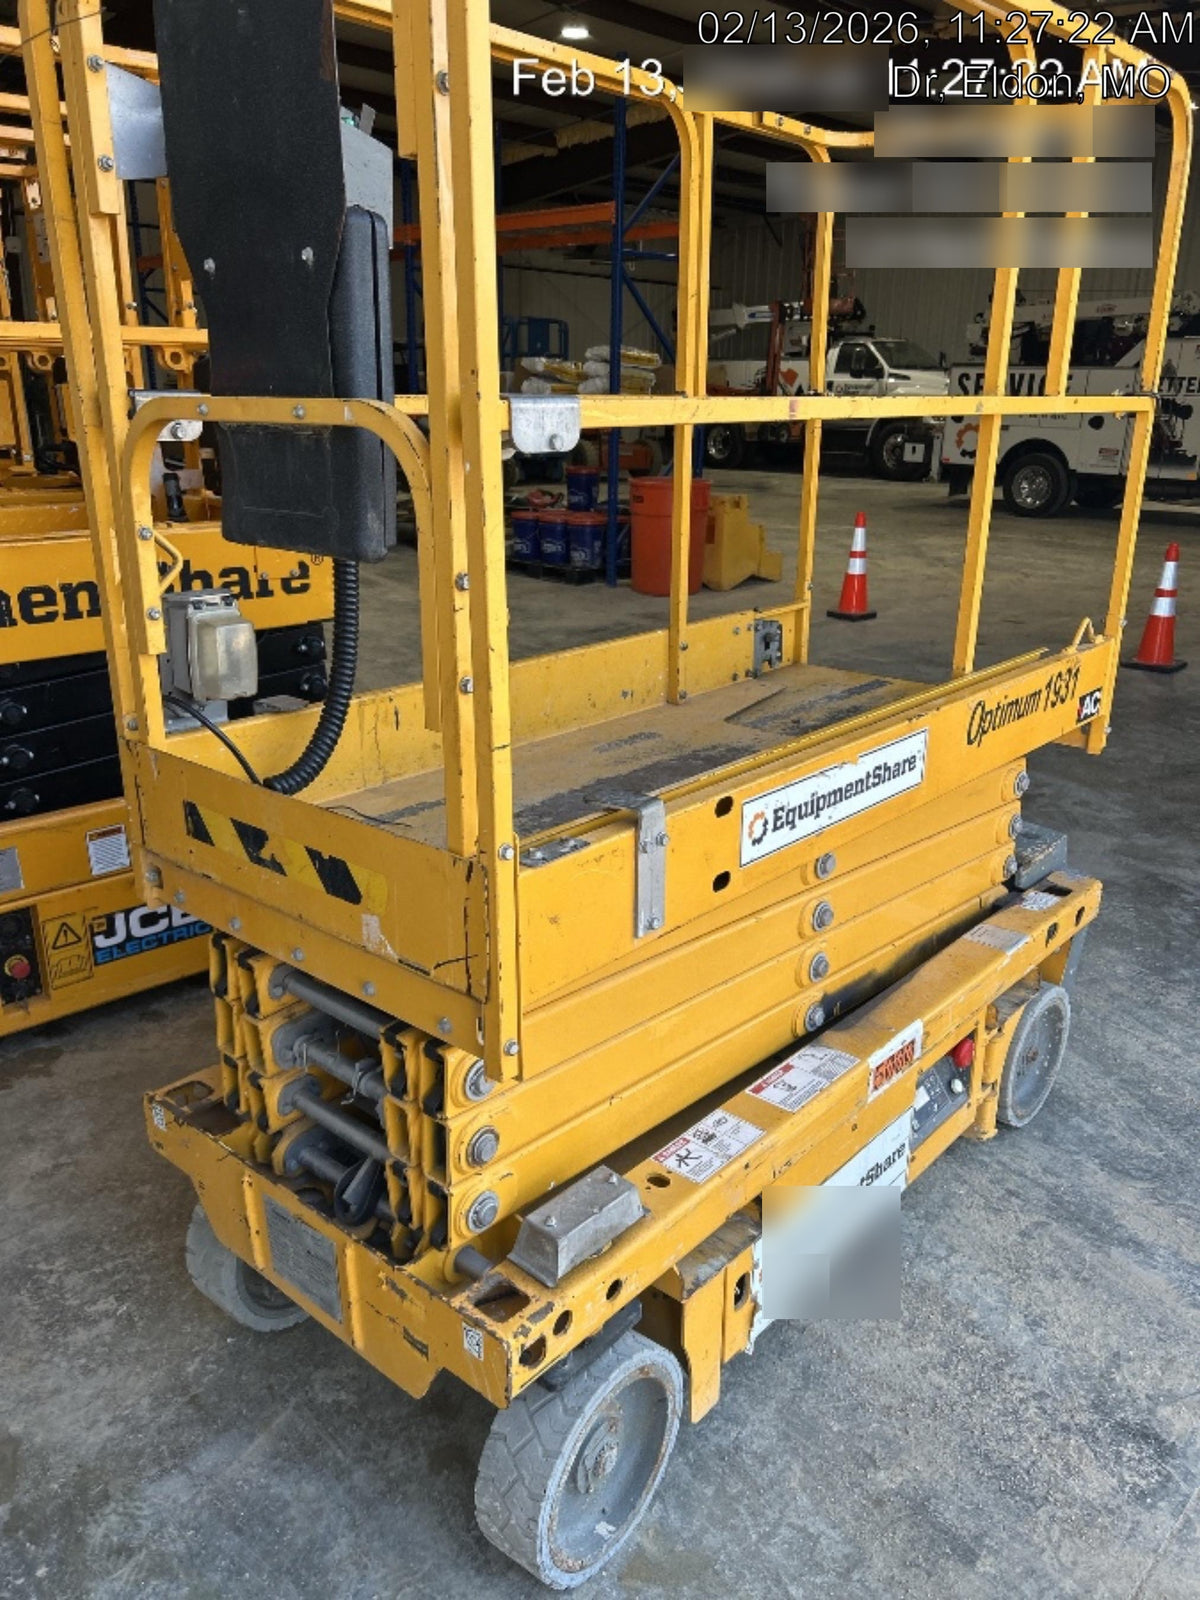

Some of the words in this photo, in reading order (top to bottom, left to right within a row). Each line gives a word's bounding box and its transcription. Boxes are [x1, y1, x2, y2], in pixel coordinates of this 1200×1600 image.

[966, 688, 1043, 748] Optimum
[1043, 664, 1081, 713] 1931
[1080, 689, 1102, 720] AC
[770, 753, 918, 833] EquipmentShare
[95, 920, 212, 966] ELECTRIC
